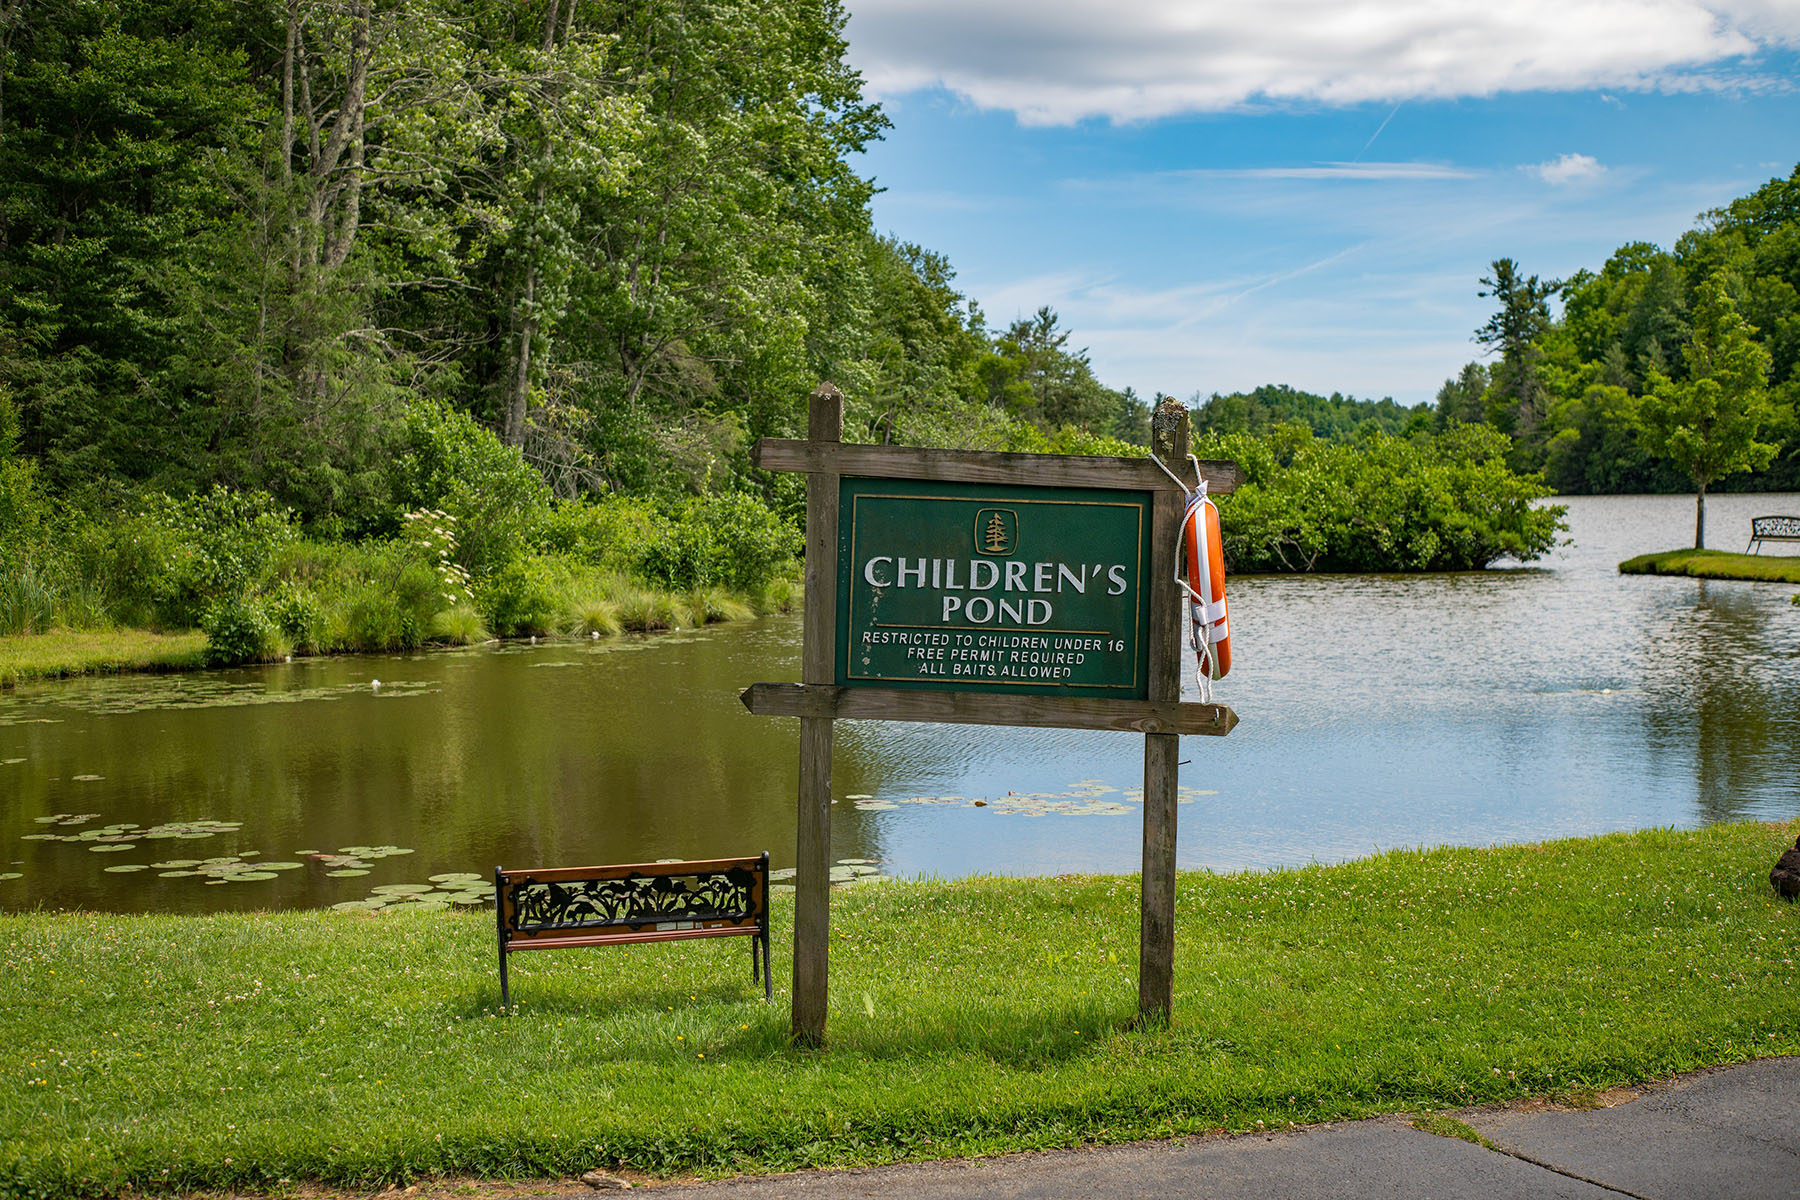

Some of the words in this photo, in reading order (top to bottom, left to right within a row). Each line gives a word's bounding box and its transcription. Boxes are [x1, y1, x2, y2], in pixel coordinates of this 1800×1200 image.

[864, 556, 1127, 595] CHILDREN'S
[942, 596, 1053, 625] POND
[862, 631, 950, 646] RESTRICTED
[955, 634, 973, 647] TO
[978, 635, 1049, 649] CHILDREN
[1054, 637, 1102, 651] UNDER
[1107, 640, 1124, 652] 16
[907, 647, 944, 660] FREE
[950, 649, 1004, 662] PERMIT
[1010, 650, 1085, 665] REQUIRED
[919, 662, 946, 675] ALL
[953, 663, 995, 676] BAITS
[1000, 664, 1071, 678] ALLOWED
